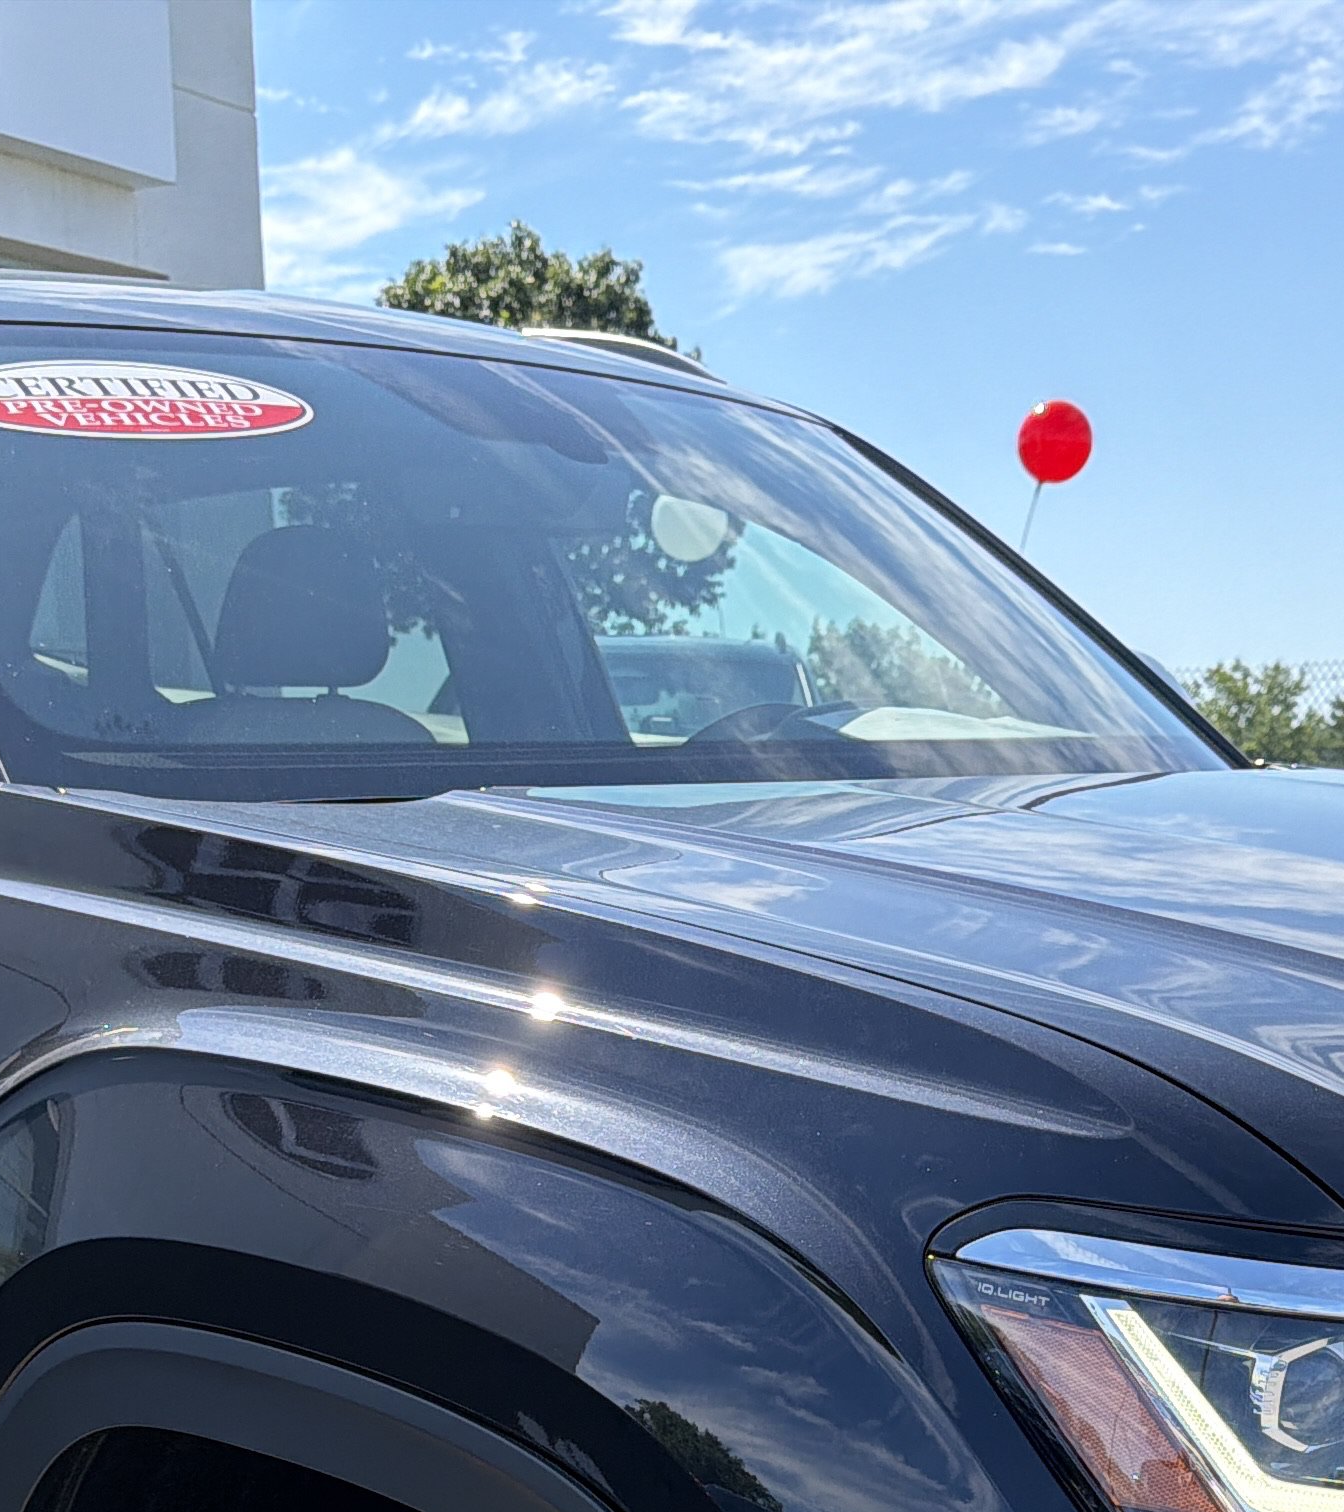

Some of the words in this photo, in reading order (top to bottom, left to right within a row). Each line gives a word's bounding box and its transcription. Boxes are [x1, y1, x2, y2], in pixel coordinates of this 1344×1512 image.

[1, 400, 263, 416] PRE-OWNED
[37, 412, 251, 428] VEHICLES
[977, 1281, 1050, 1306] IQ.LIGHT
